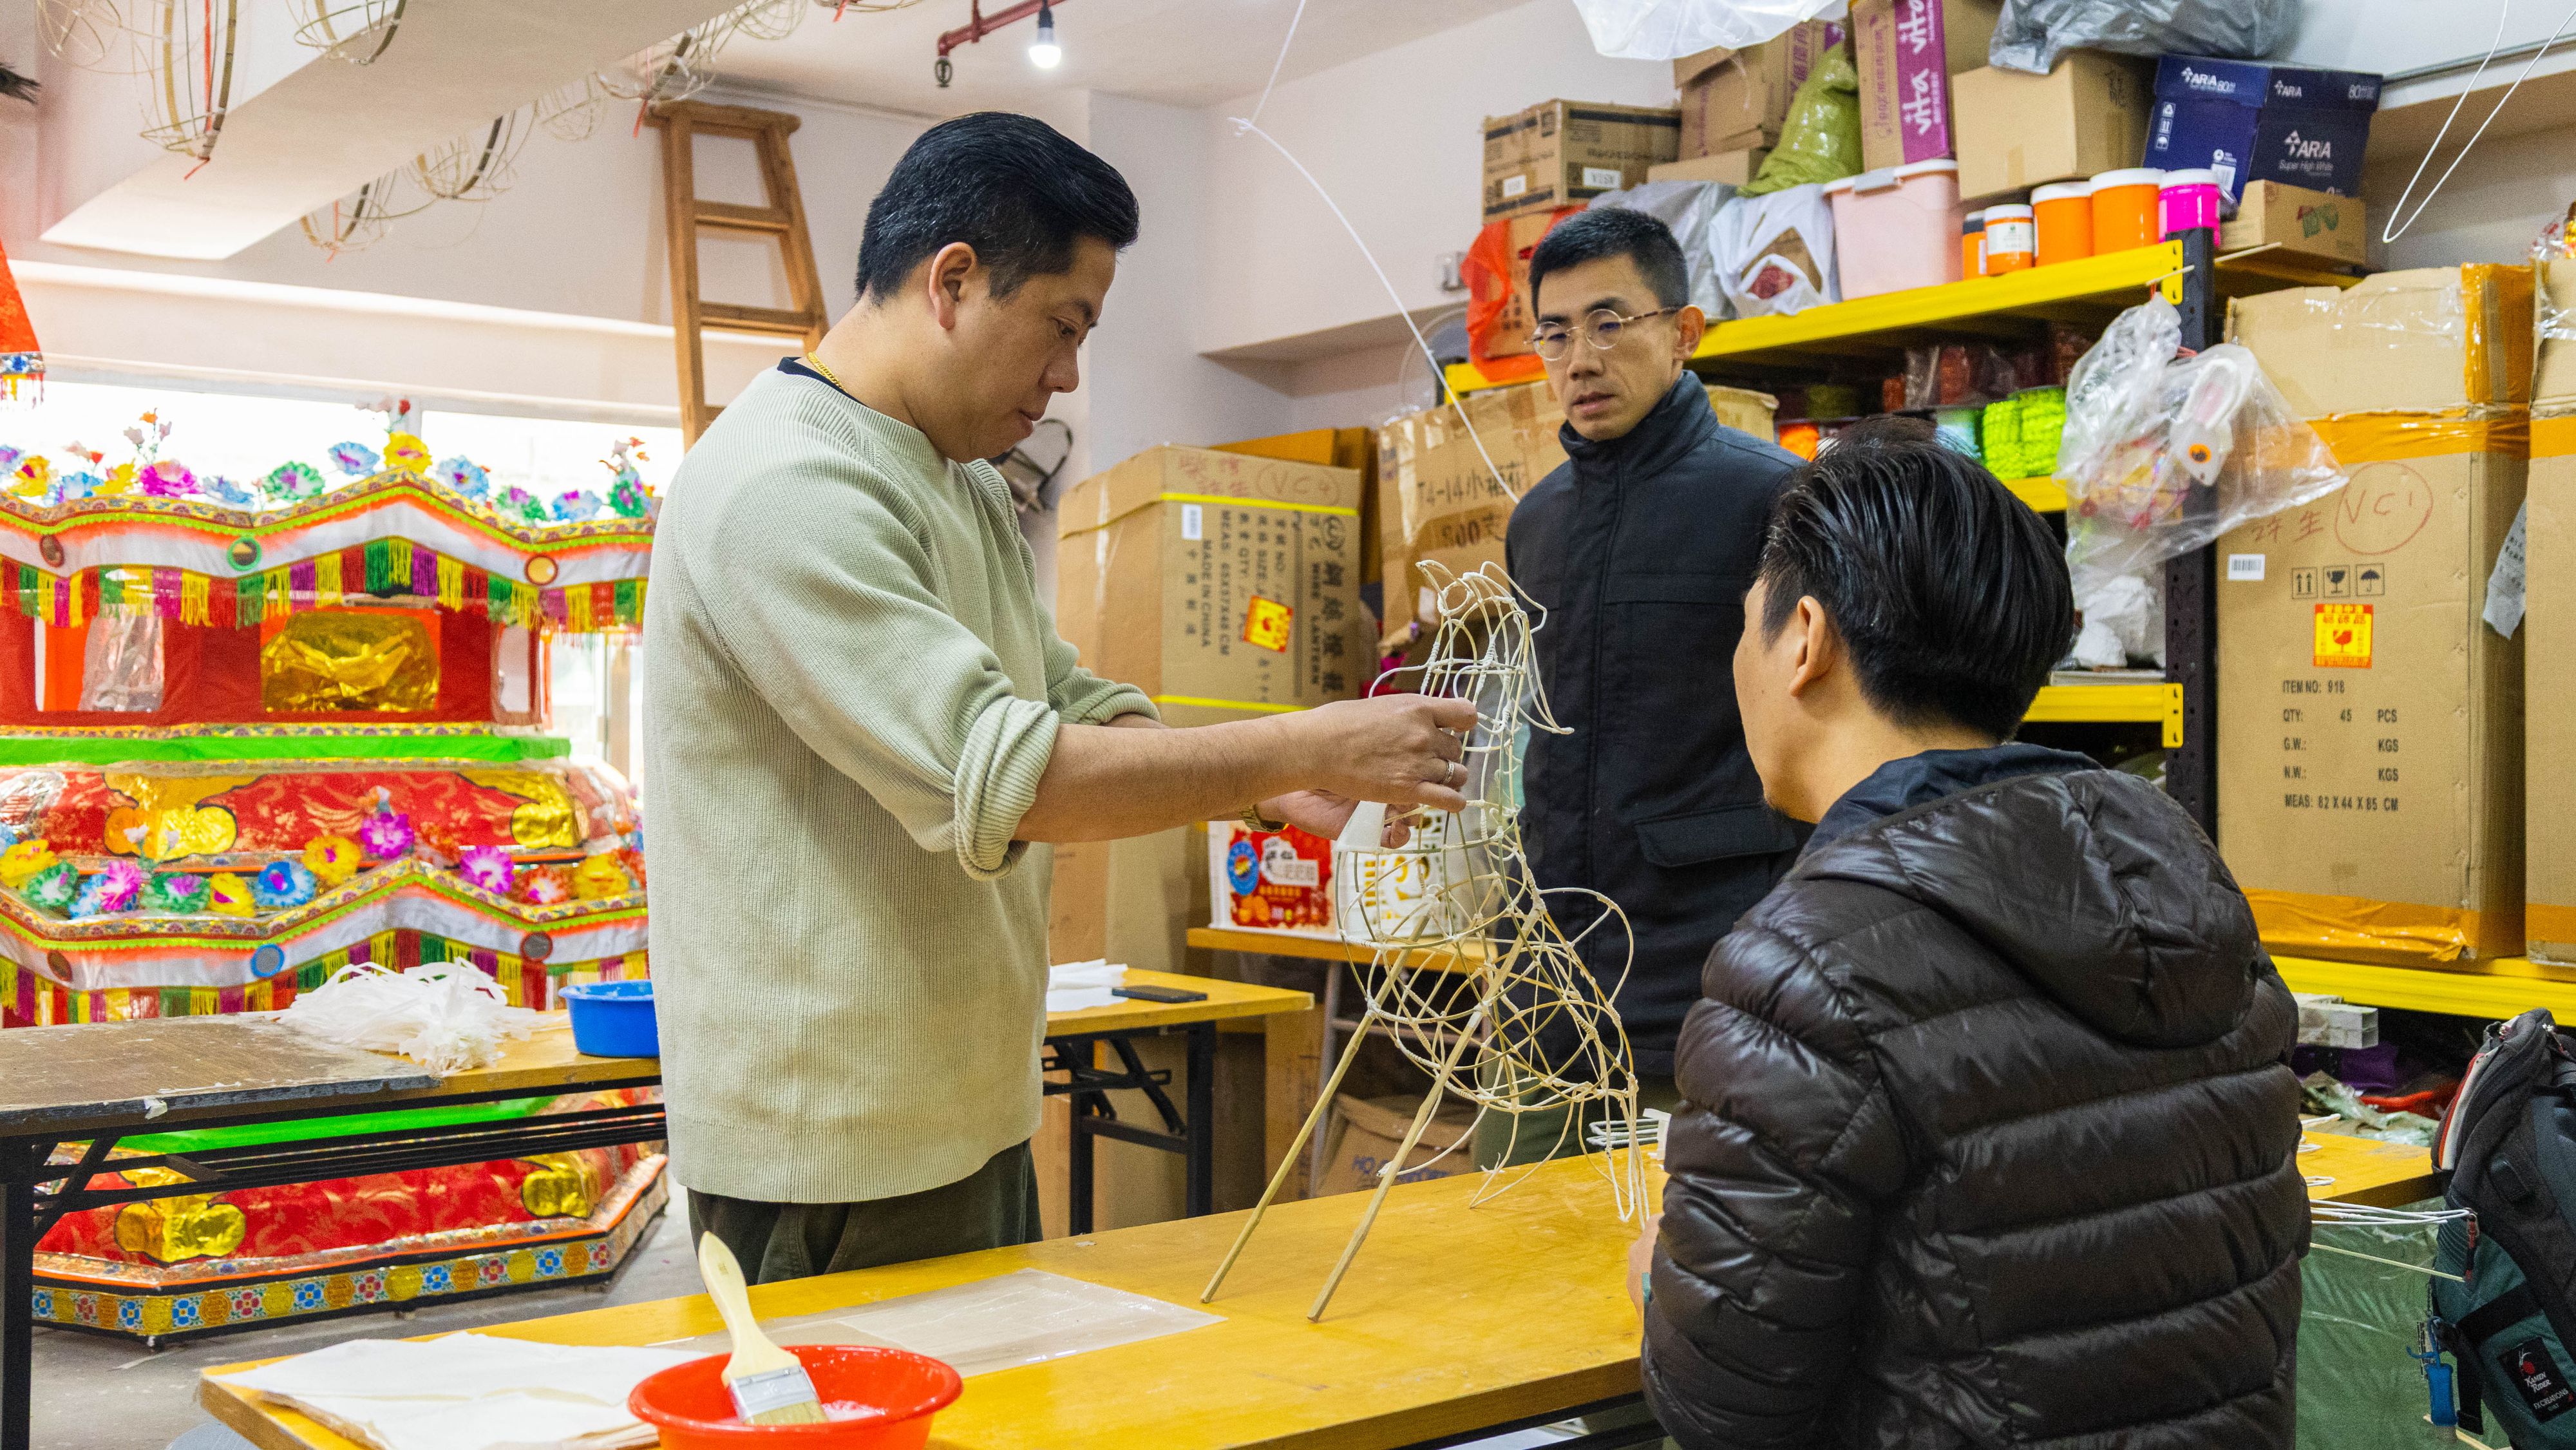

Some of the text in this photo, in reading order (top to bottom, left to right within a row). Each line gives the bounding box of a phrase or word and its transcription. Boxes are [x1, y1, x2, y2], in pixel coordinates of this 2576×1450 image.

[1902, 68, 1933, 135] vita
[2297, 140, 2331, 159] ARIA
[1202, 539, 1211, 647] MADE IN CHINA
[2283, 680, 2303, 694] ITEM
[2328, 680, 2345, 694] 918
[2284, 709, 2398, 723] QTY: 45 PCS
[2378, 739, 2399, 752] KGS
[2378, 768, 2399, 781] KGS
[2384, 798, 2398, 812] CM
